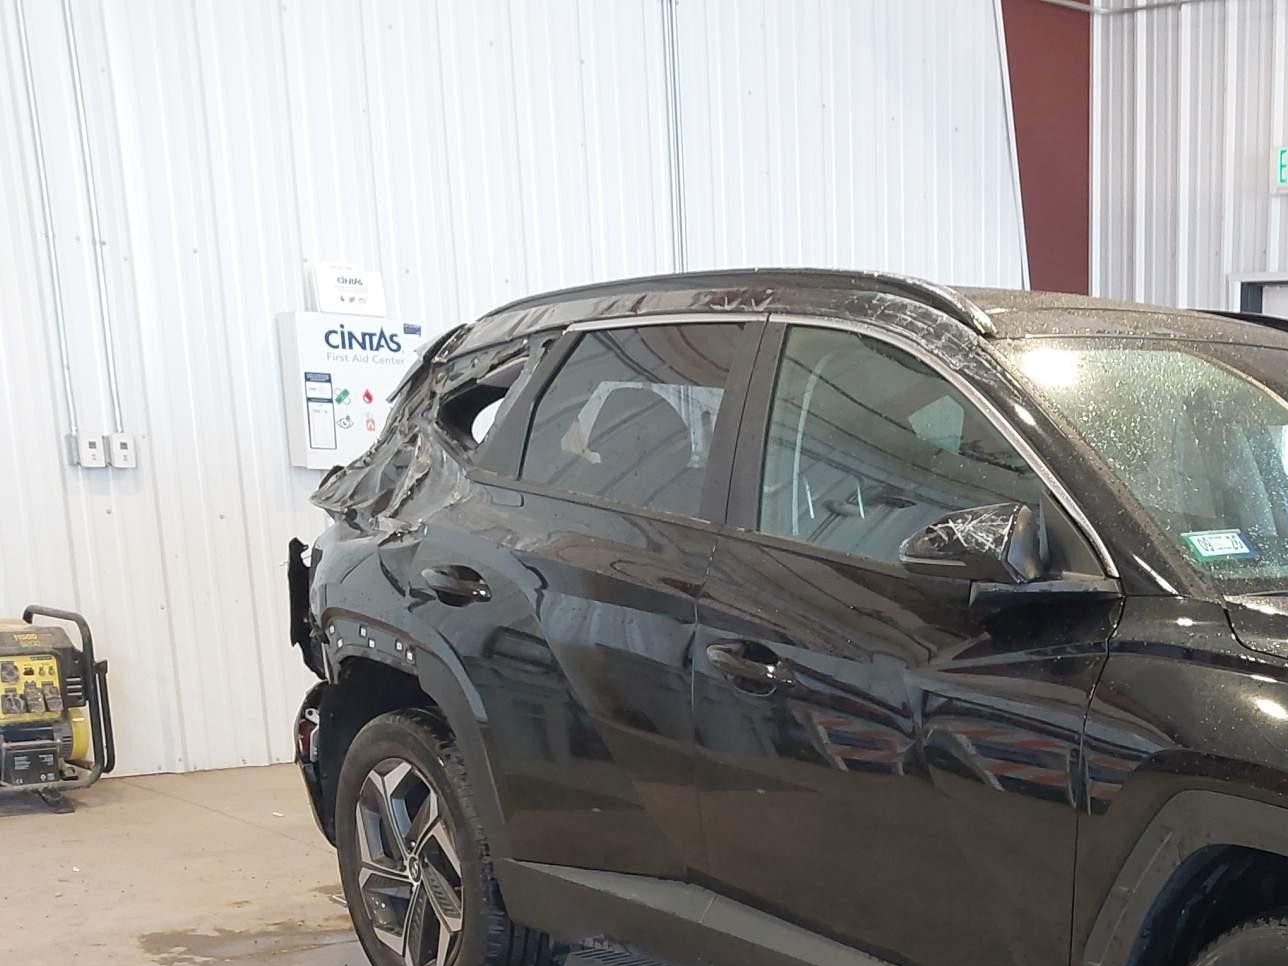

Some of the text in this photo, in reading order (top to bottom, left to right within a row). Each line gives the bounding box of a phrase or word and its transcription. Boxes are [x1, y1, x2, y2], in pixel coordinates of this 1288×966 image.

[327, 352, 405, 366] First Aid Center
